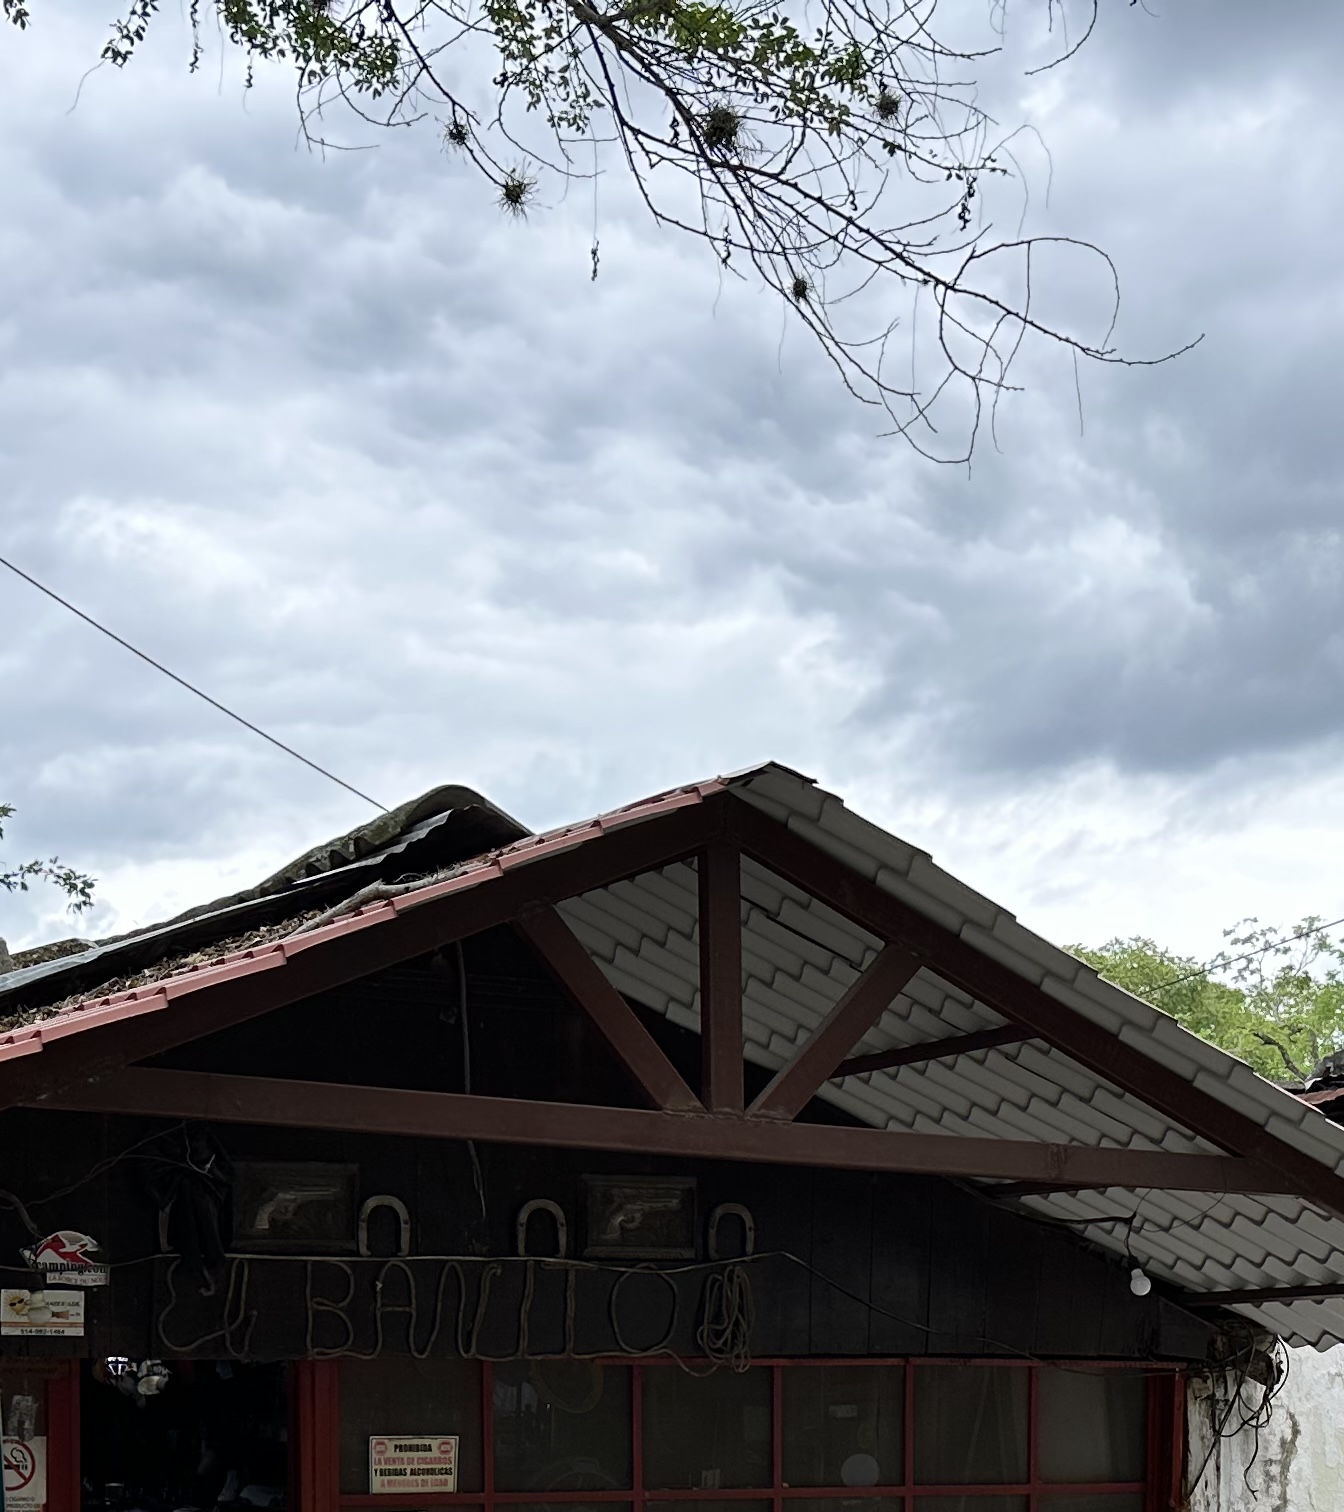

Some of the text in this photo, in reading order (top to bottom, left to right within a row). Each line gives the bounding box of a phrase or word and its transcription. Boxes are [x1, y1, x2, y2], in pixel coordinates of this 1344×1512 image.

[393, 1444, 434, 1453] PROHIBIDA
[374, 1457, 382, 1465] LA
[383, 1457, 405, 1465] VENTA
[417, 1456, 452, 1465] CIGARROS
[374, 1468, 379, 1476] Y
[379, 1468, 407, 1476] BEBIDAS
[380, 1480, 385, 1488] A
[387, 1479, 419, 1488] MENORES
[421, 1479, 429, 1487] DE
